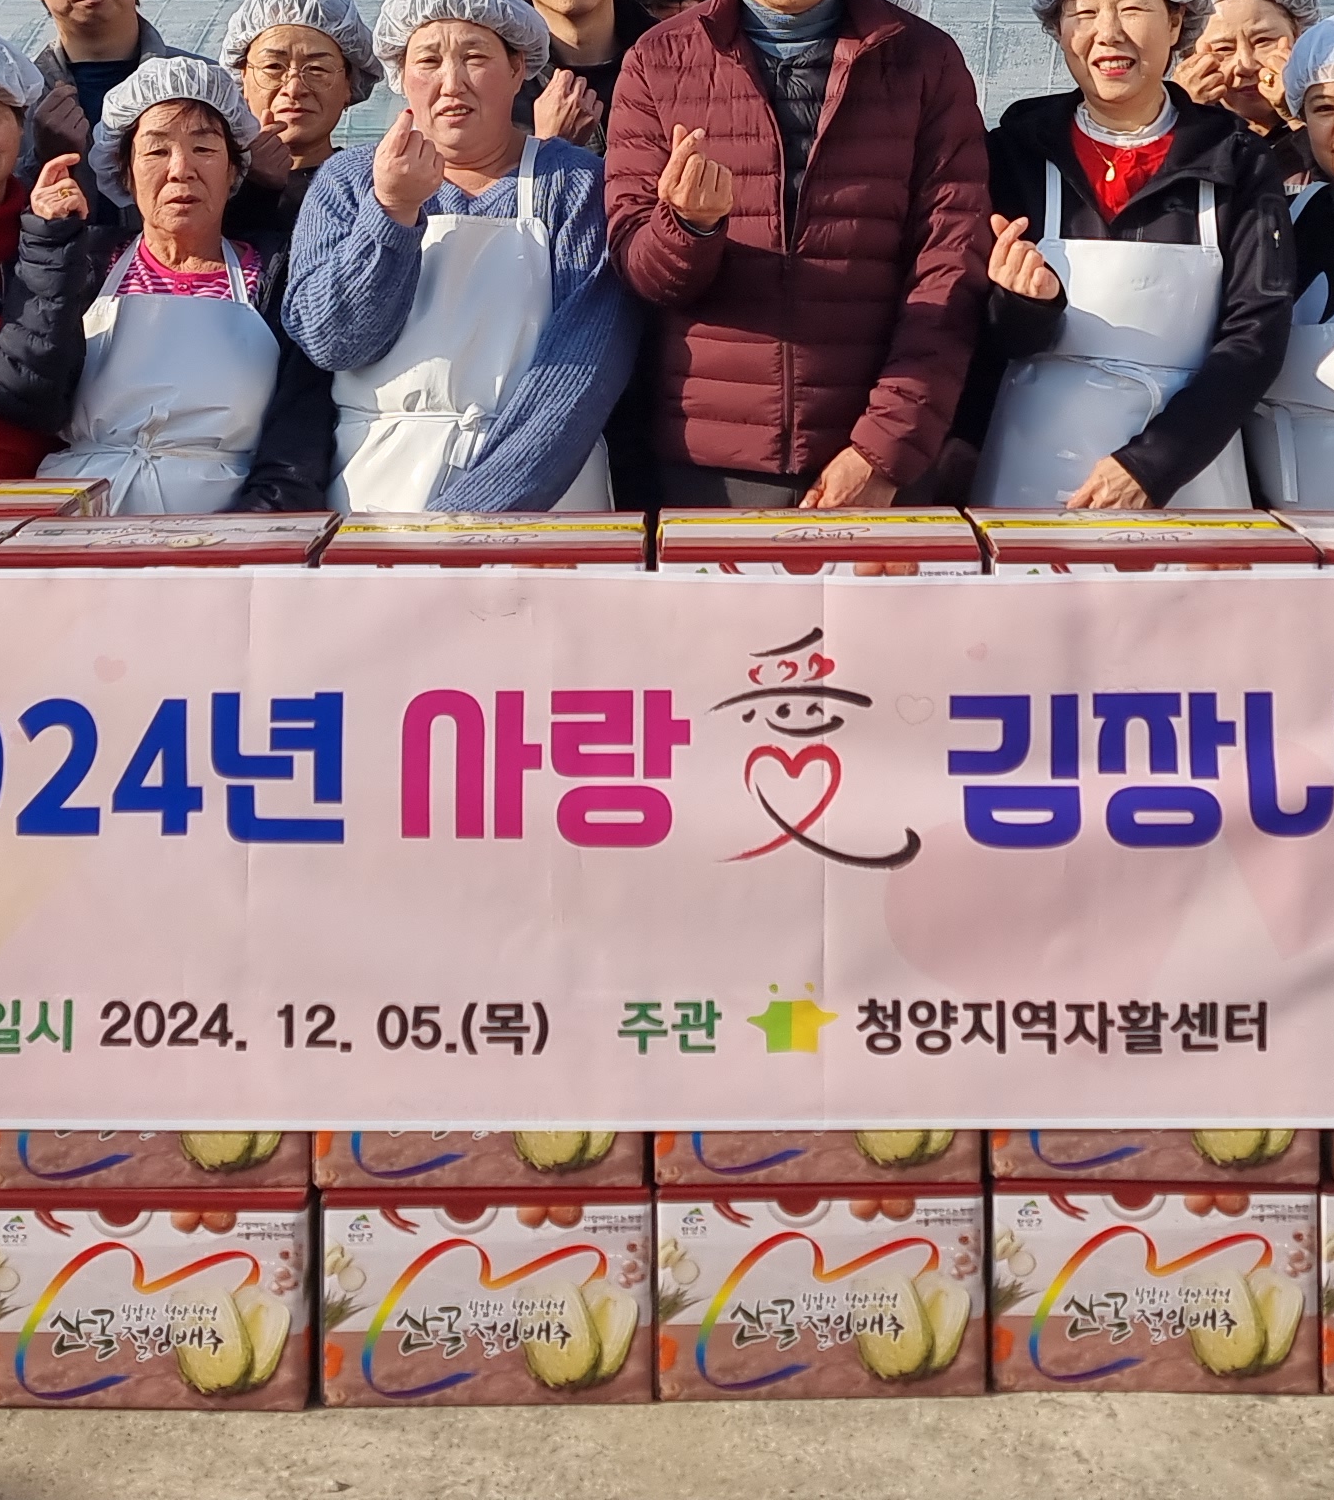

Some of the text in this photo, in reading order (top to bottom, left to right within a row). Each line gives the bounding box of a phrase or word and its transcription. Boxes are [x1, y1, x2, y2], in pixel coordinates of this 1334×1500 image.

[402, 690, 690, 847] 사랑
[100, 1000, 247, 1052] 2024.
[277, 1003, 352, 1053] 12.
[376, 1001, 549, 1056] 05.(목)
[617, 998, 1267, 1055] 주관 청양지역자활센터
[49, 1308, 225, 1363] 산골 절임배추
[396, 1305, 572, 1358] 산골 절임배추
[729, 1298, 905, 1350] 산골 절임배추
[1063, 1291, 1238, 1345] 산골 절임배추
